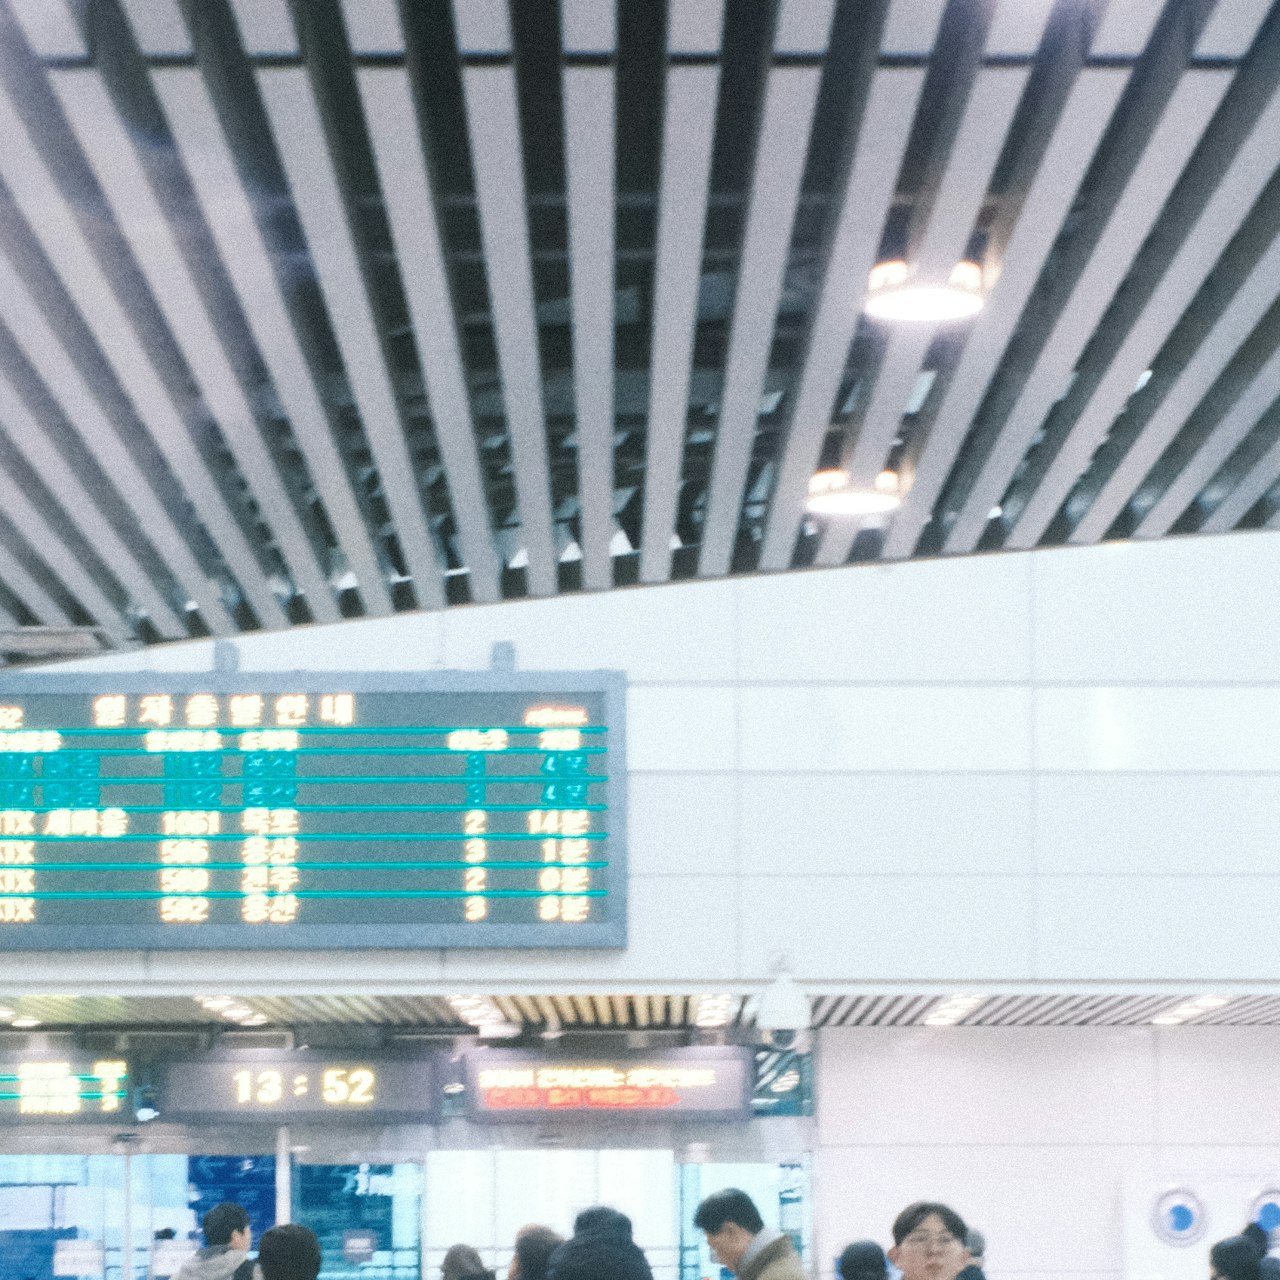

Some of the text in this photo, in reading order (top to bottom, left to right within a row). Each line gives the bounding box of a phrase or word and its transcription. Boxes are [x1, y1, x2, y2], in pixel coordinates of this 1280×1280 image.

[465, 810, 486, 834] 2
[465, 867, 486, 892] 2
[233, 1070, 375, 1103] 13:52
